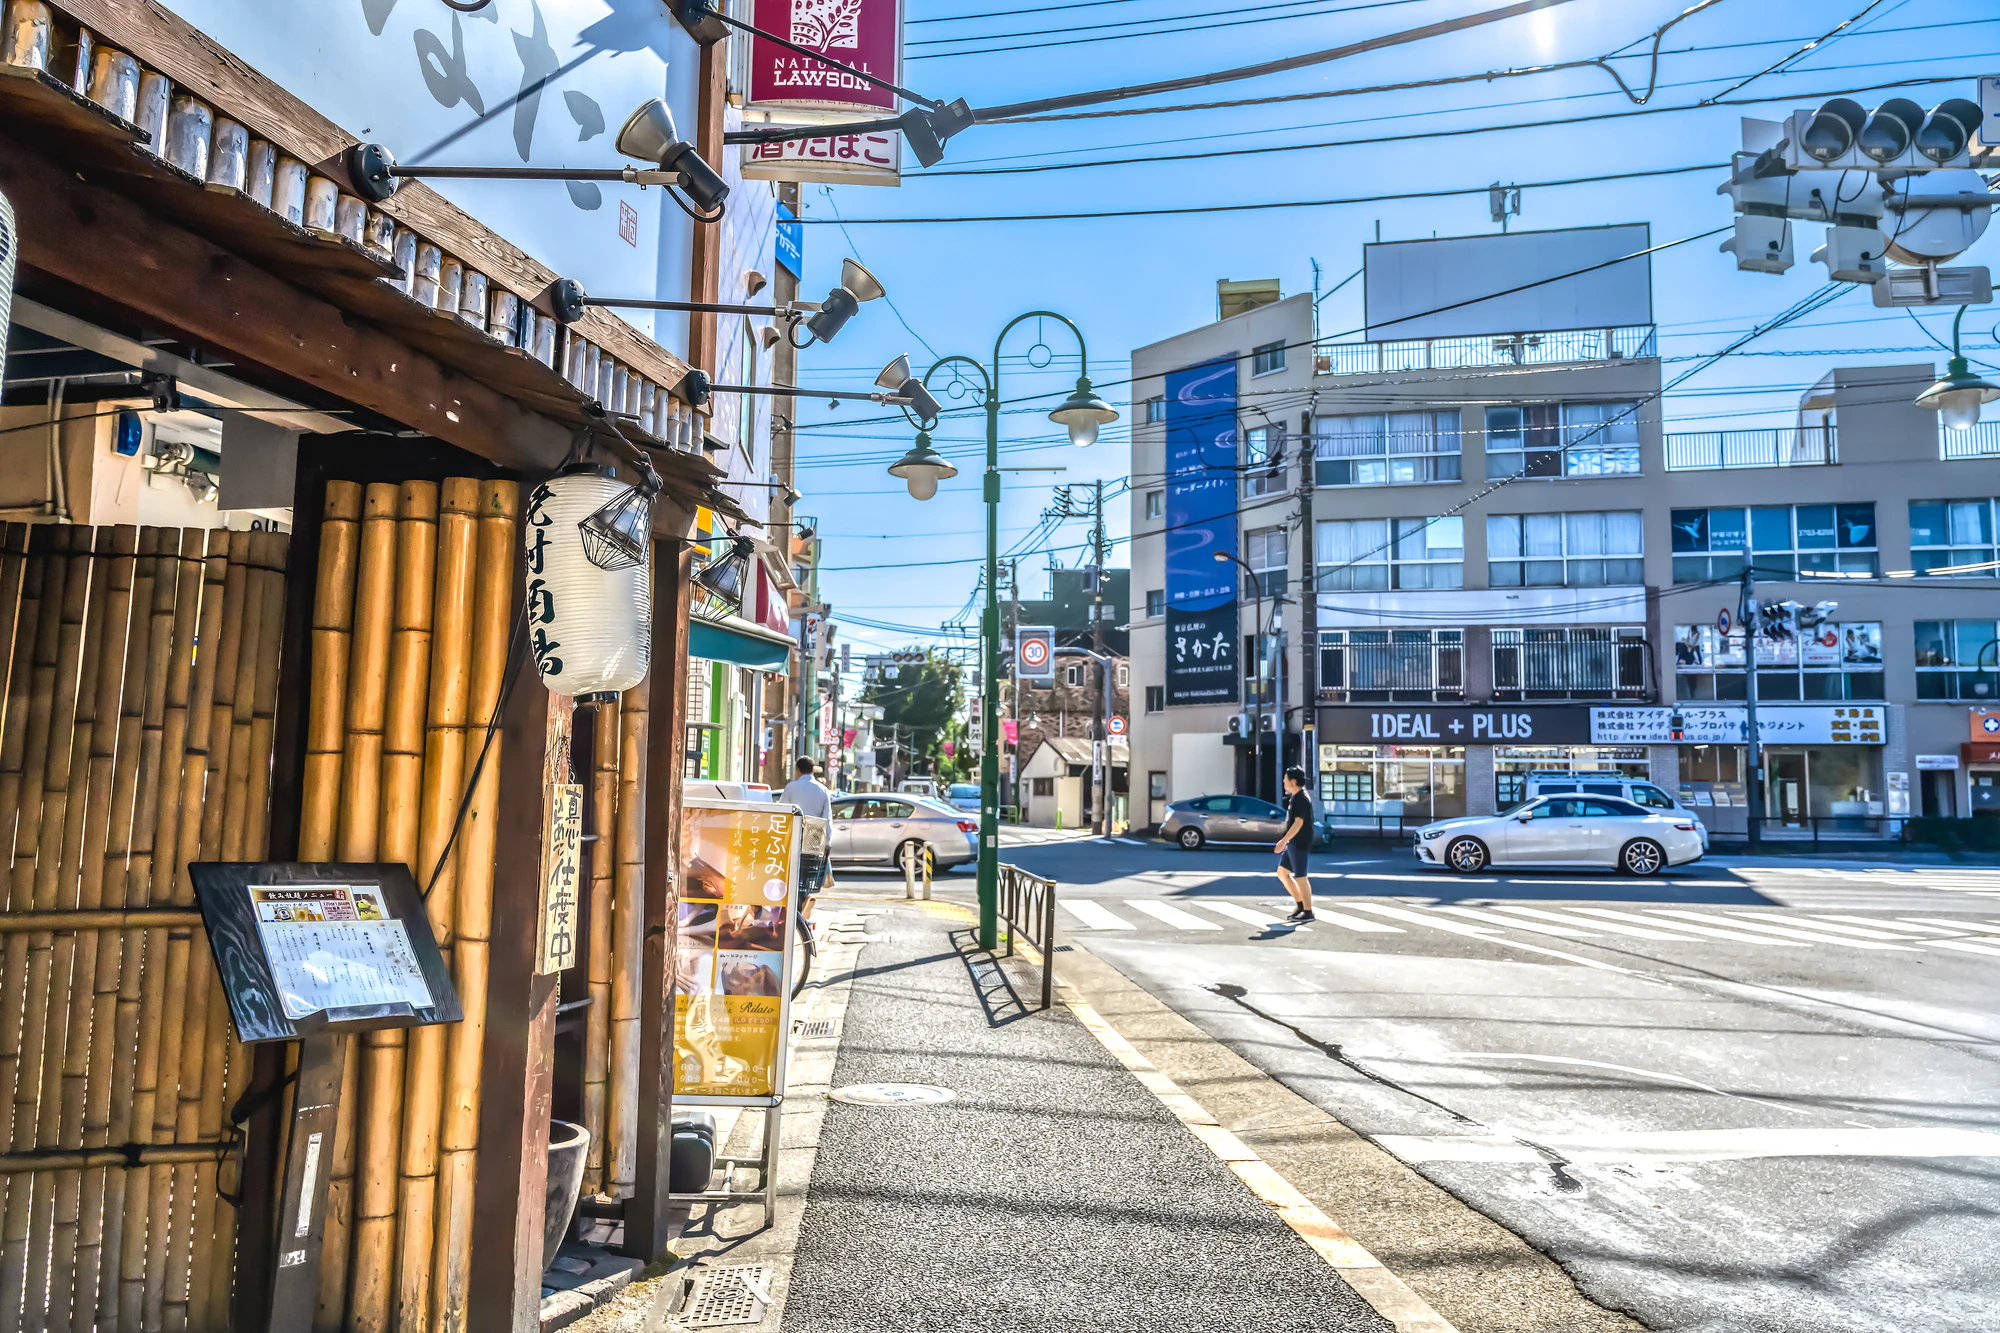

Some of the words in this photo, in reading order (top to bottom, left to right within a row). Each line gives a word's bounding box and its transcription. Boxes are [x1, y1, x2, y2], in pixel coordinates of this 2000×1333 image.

[773, 70, 872, 91] LAWSON
[1028, 646, 1043, 659] 30
[1174, 632, 1231, 663] さかた
[1371, 713, 1441, 739] IDEAL
[1448, 718, 1465, 735] +
[1472, 713, 1533, 739] PLUS
[746, 812, 762, 881] アロマオイル
[764, 814, 787, 877] 足ふみ
[739, 1001, 775, 1014] Rilato
